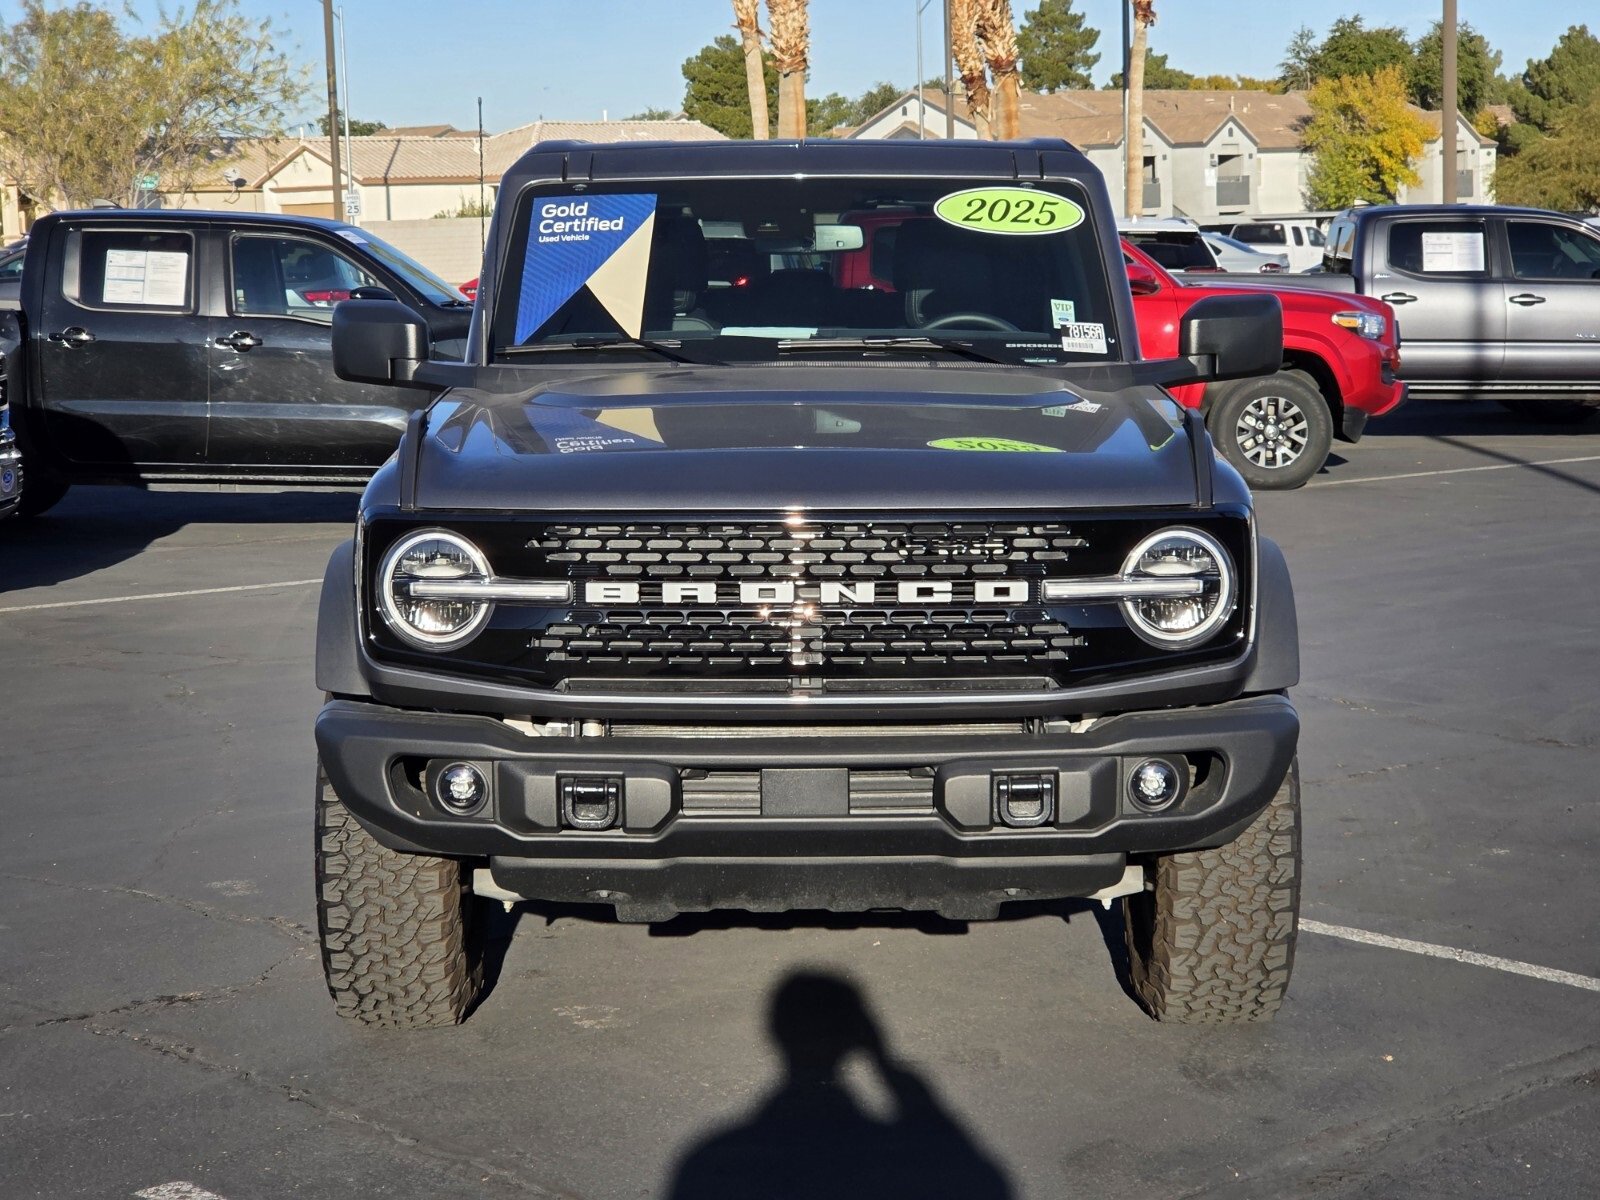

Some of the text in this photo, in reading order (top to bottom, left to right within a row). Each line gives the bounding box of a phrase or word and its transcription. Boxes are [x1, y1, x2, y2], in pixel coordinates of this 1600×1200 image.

[347, 205, 360, 214] 25
[541, 202, 589, 218] Gold
[962, 198, 1060, 226] 2025
[539, 216, 624, 234] Certified
[538, 233, 590, 243] Used Vehicle
[1053, 303, 1072, 312] VIP
[1066, 324, 1102, 340] 78156A
[585, 581, 1029, 603] BRONCO
